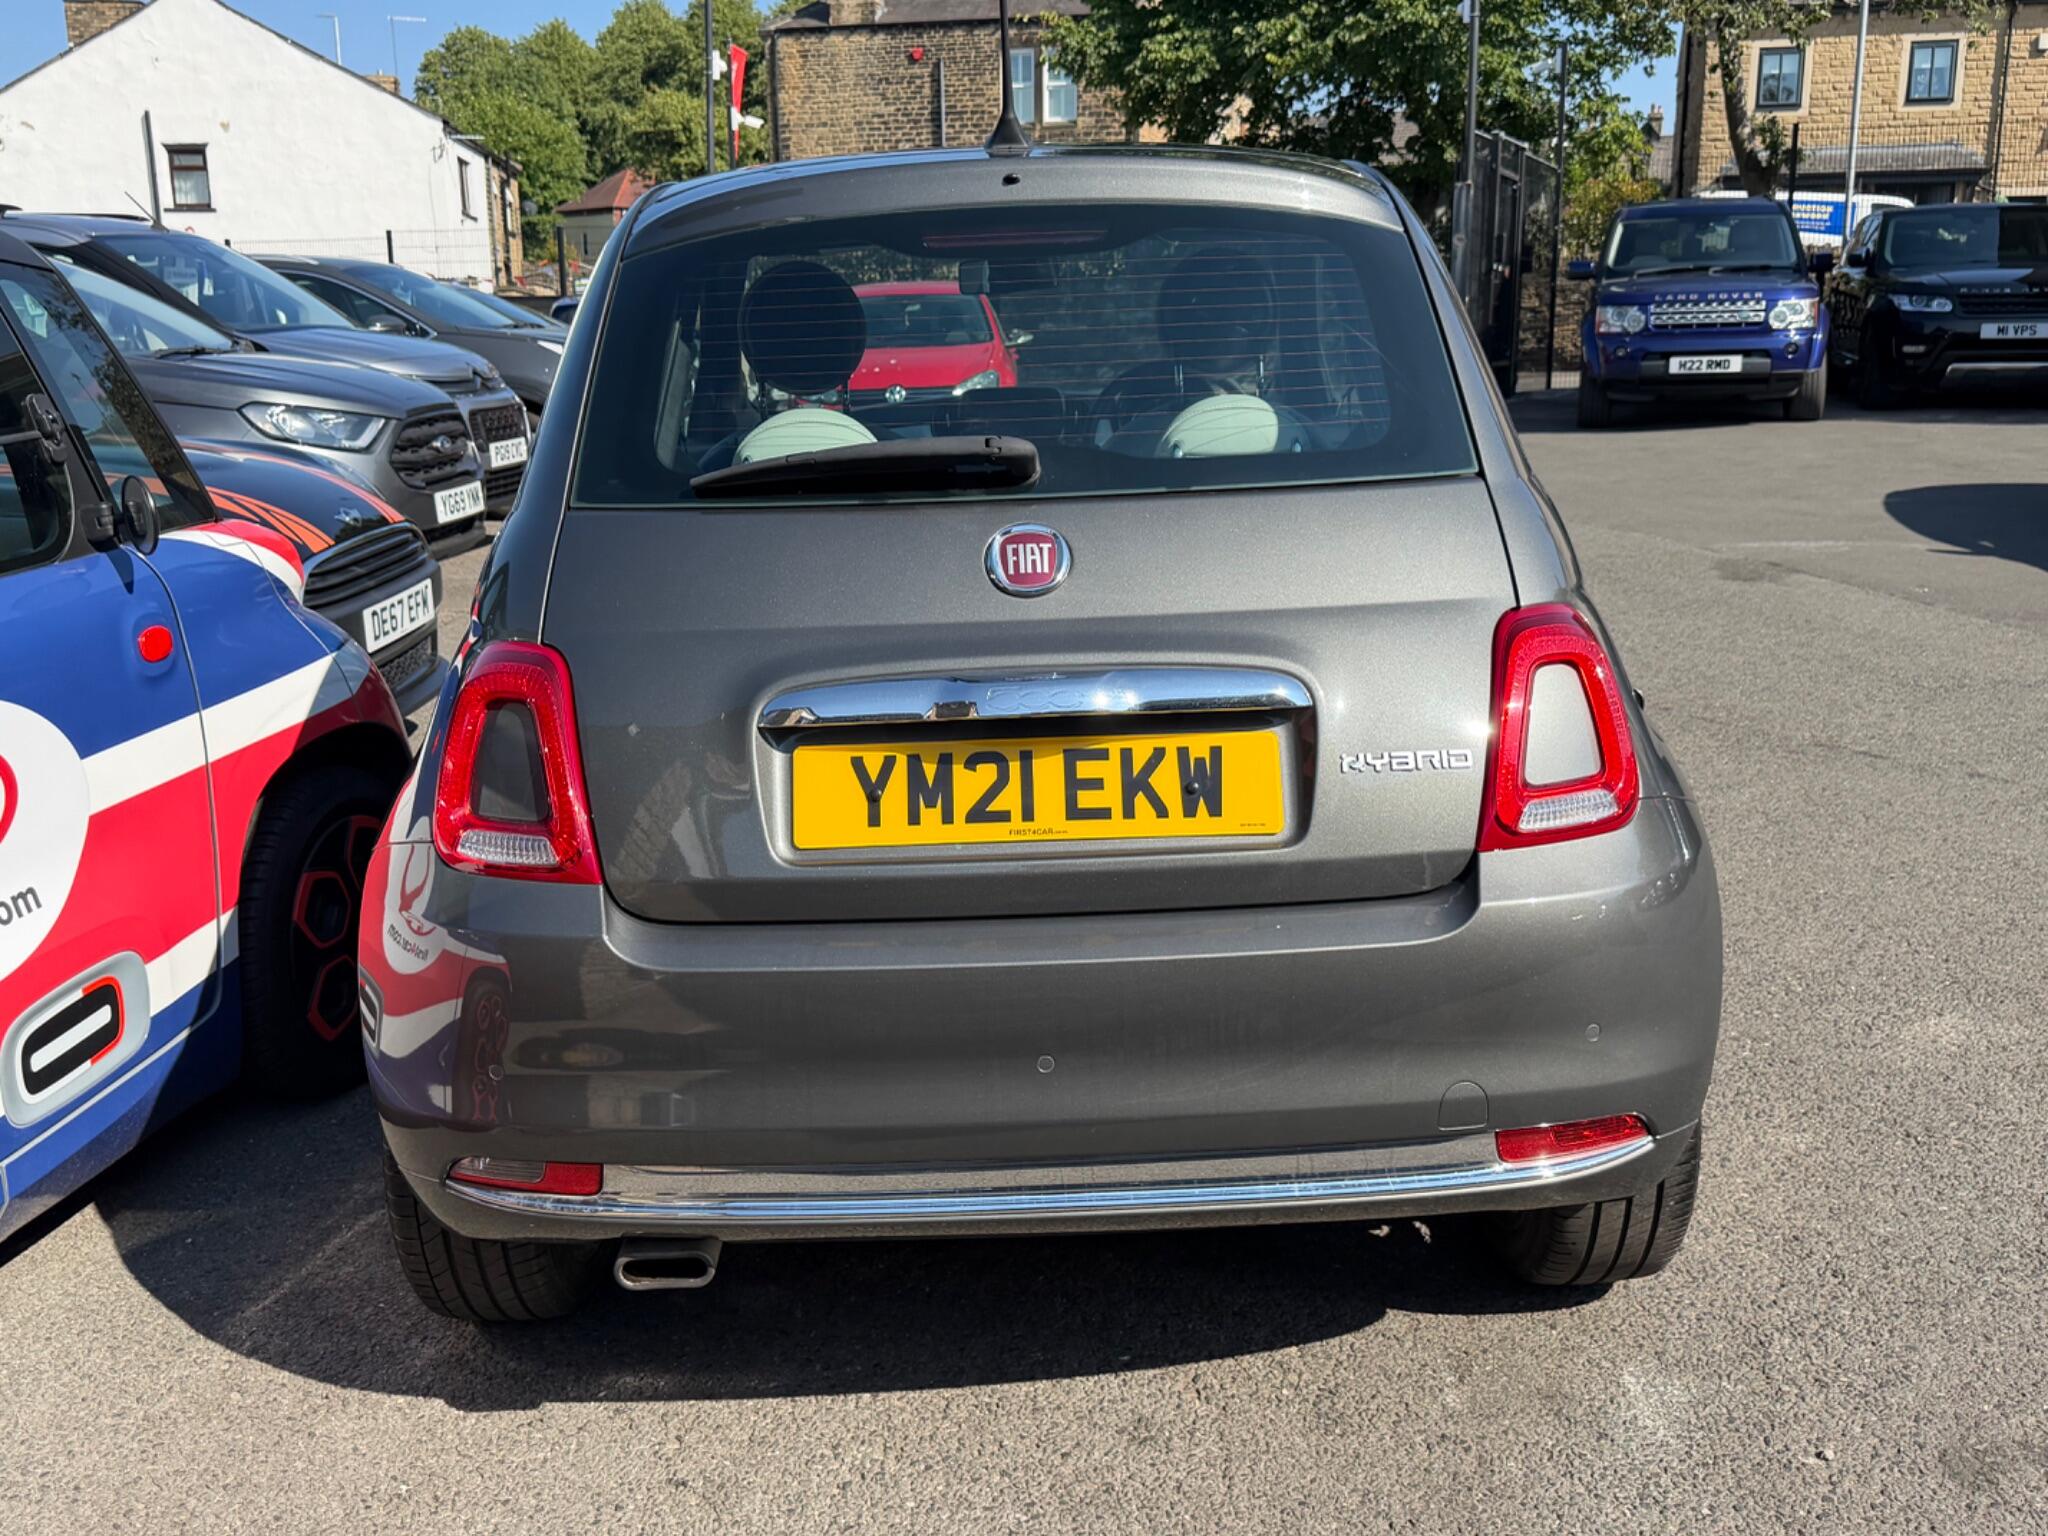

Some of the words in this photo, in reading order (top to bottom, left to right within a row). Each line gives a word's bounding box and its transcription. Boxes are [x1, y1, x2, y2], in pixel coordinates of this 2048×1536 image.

[1655, 293, 1698, 301] LAND
[1708, 291, 1763, 300] ROVER
[2013, 324, 2037, 336] VPS
[1679, 360, 1703, 371] H22
[1006, 543, 1052, 576] FIAT
[371, 598, 405, 641] DE67
[851, 749, 1035, 828] YM21
[1063, 745, 1223, 822] EKW
[0, 886, 42, 926] om
